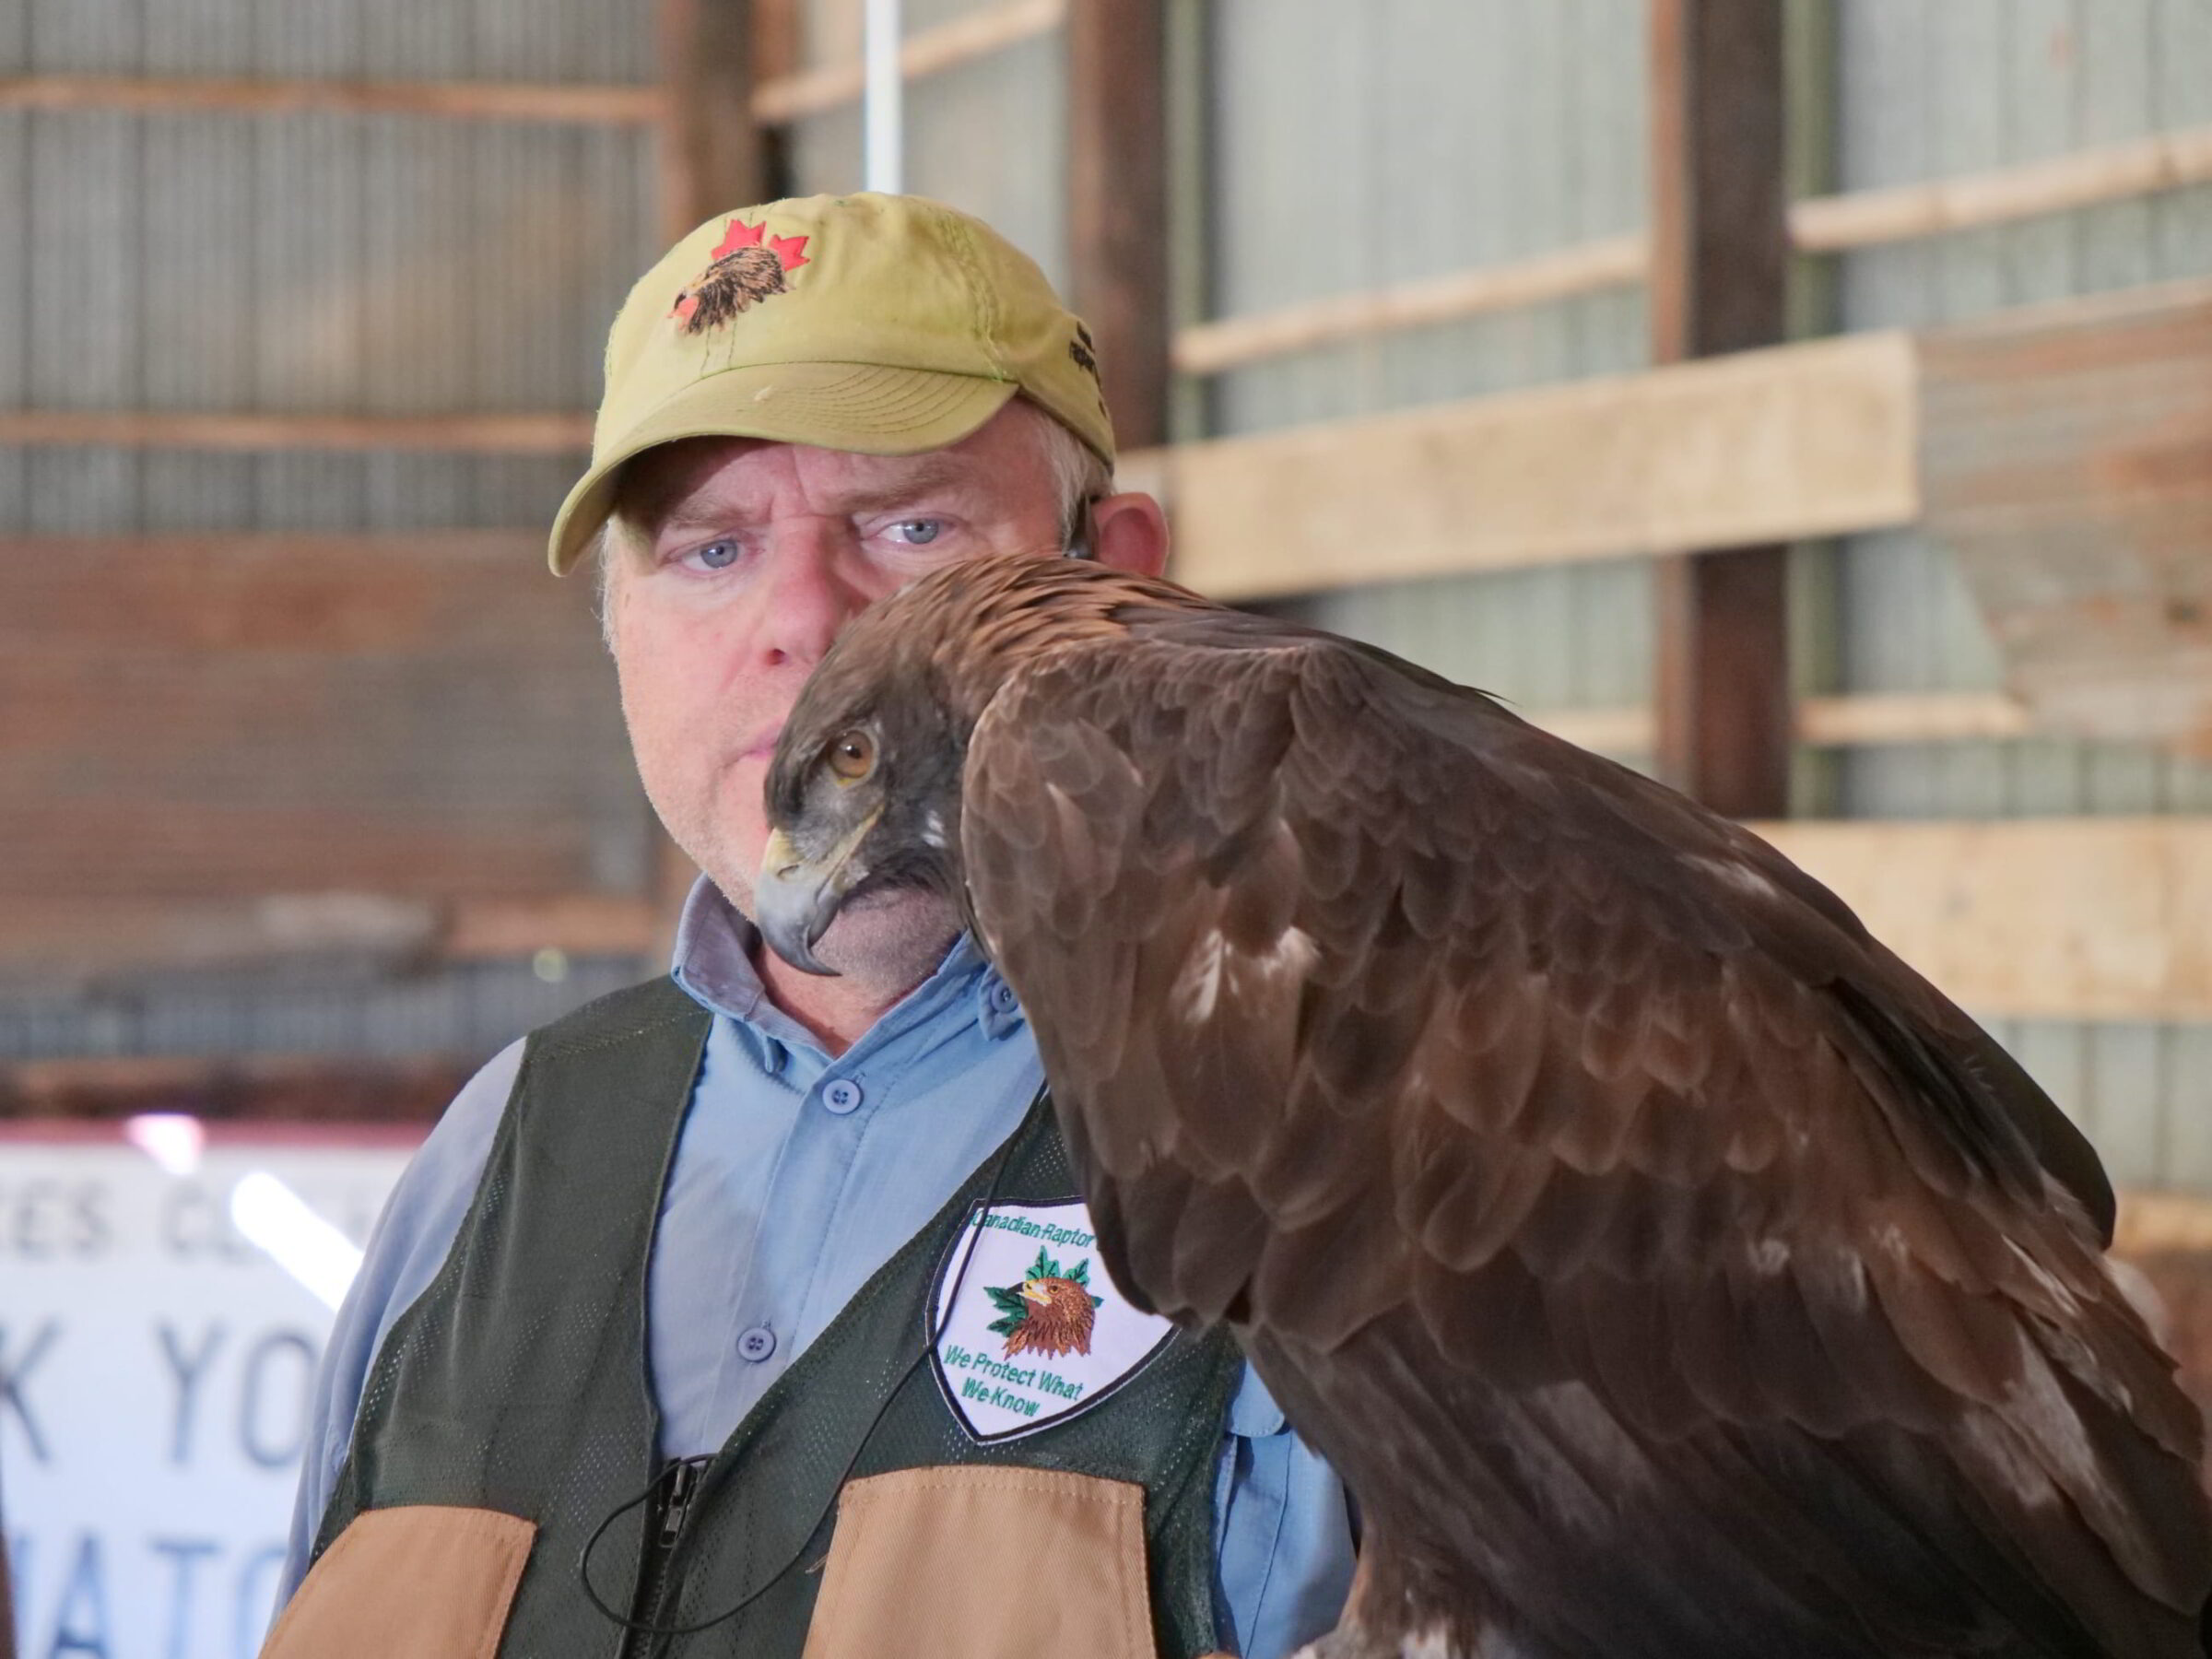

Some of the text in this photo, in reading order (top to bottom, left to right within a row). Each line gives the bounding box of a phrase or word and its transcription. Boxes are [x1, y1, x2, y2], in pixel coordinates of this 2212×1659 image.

[971, 1208, 1095, 1247] Canadian Raptor
[944, 1345, 1083, 1401] We Protect What
[961, 1377, 1041, 1417] We Know
